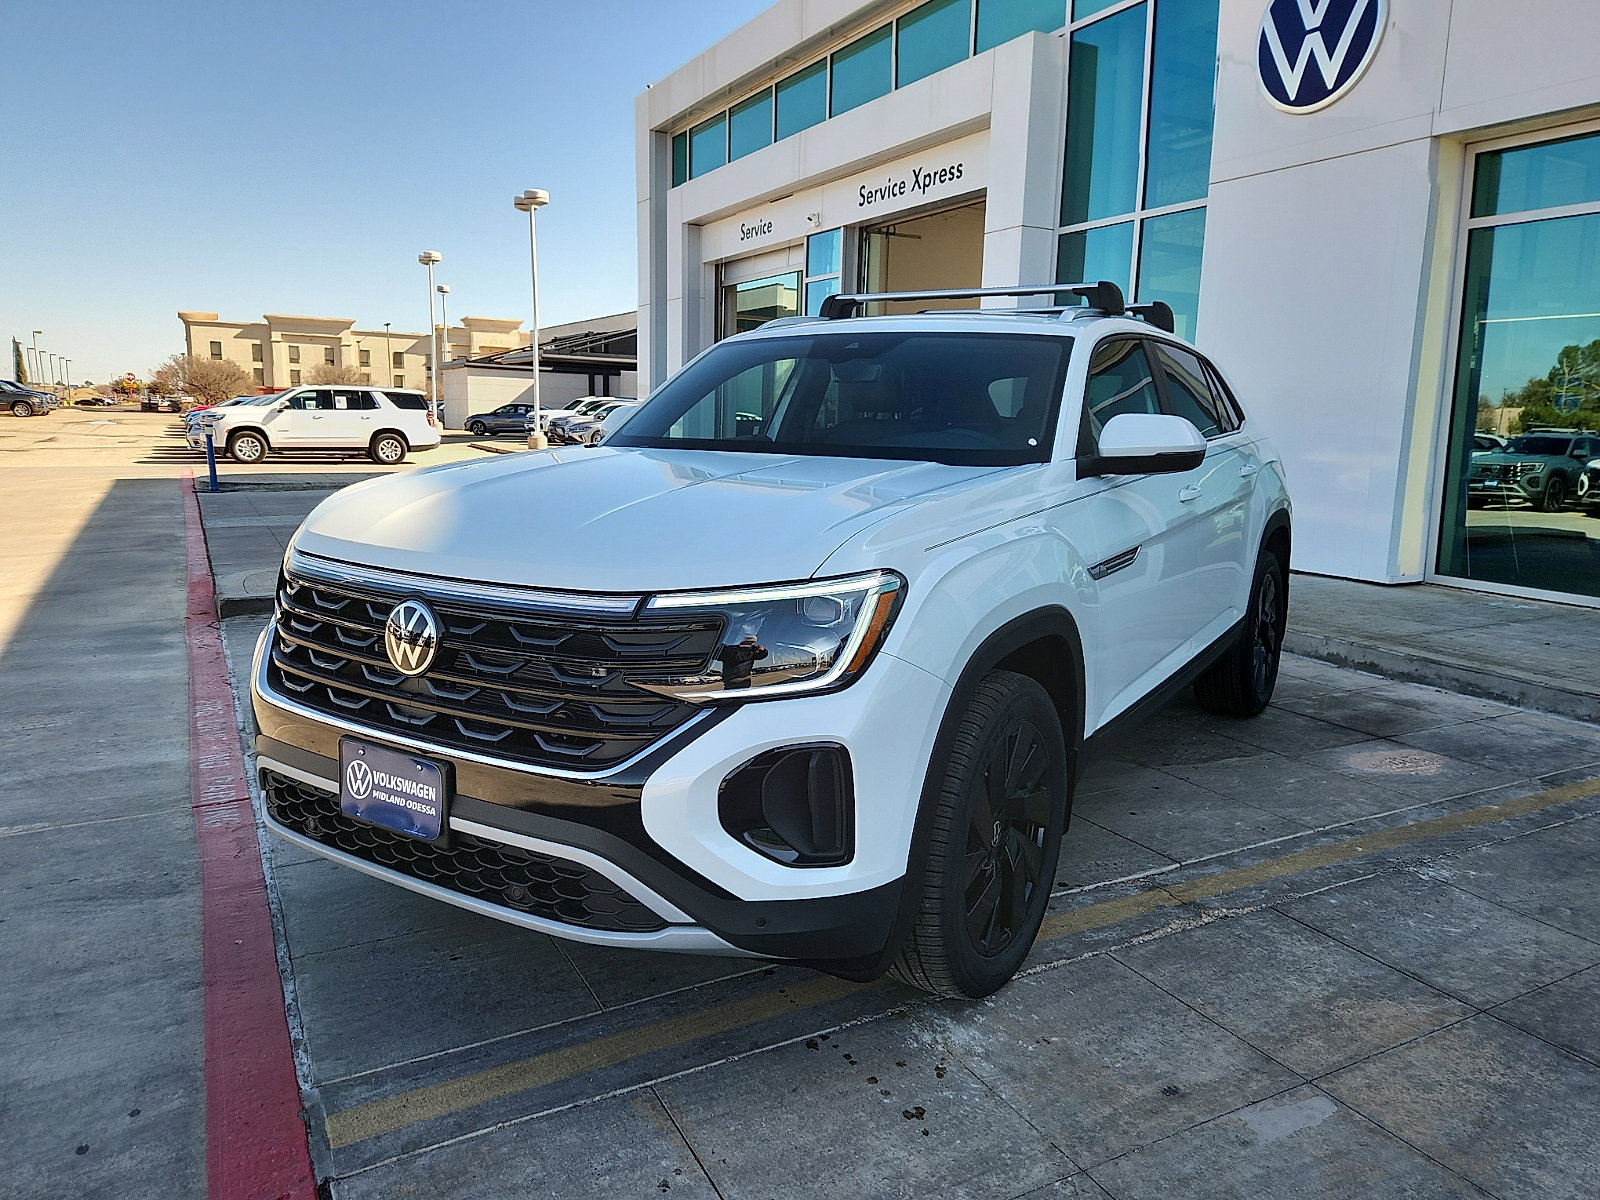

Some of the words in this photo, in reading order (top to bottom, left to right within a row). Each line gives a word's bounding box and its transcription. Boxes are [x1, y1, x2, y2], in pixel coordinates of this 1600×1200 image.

[859, 178, 906, 207] Service
[911, 162, 964, 194] Xpress
[740, 219, 773, 241] Service
[372, 770, 436, 802] VOLKSWAGEN
[372, 789, 406, 807] MIDLAND
[405, 799, 437, 816] ODESSA
